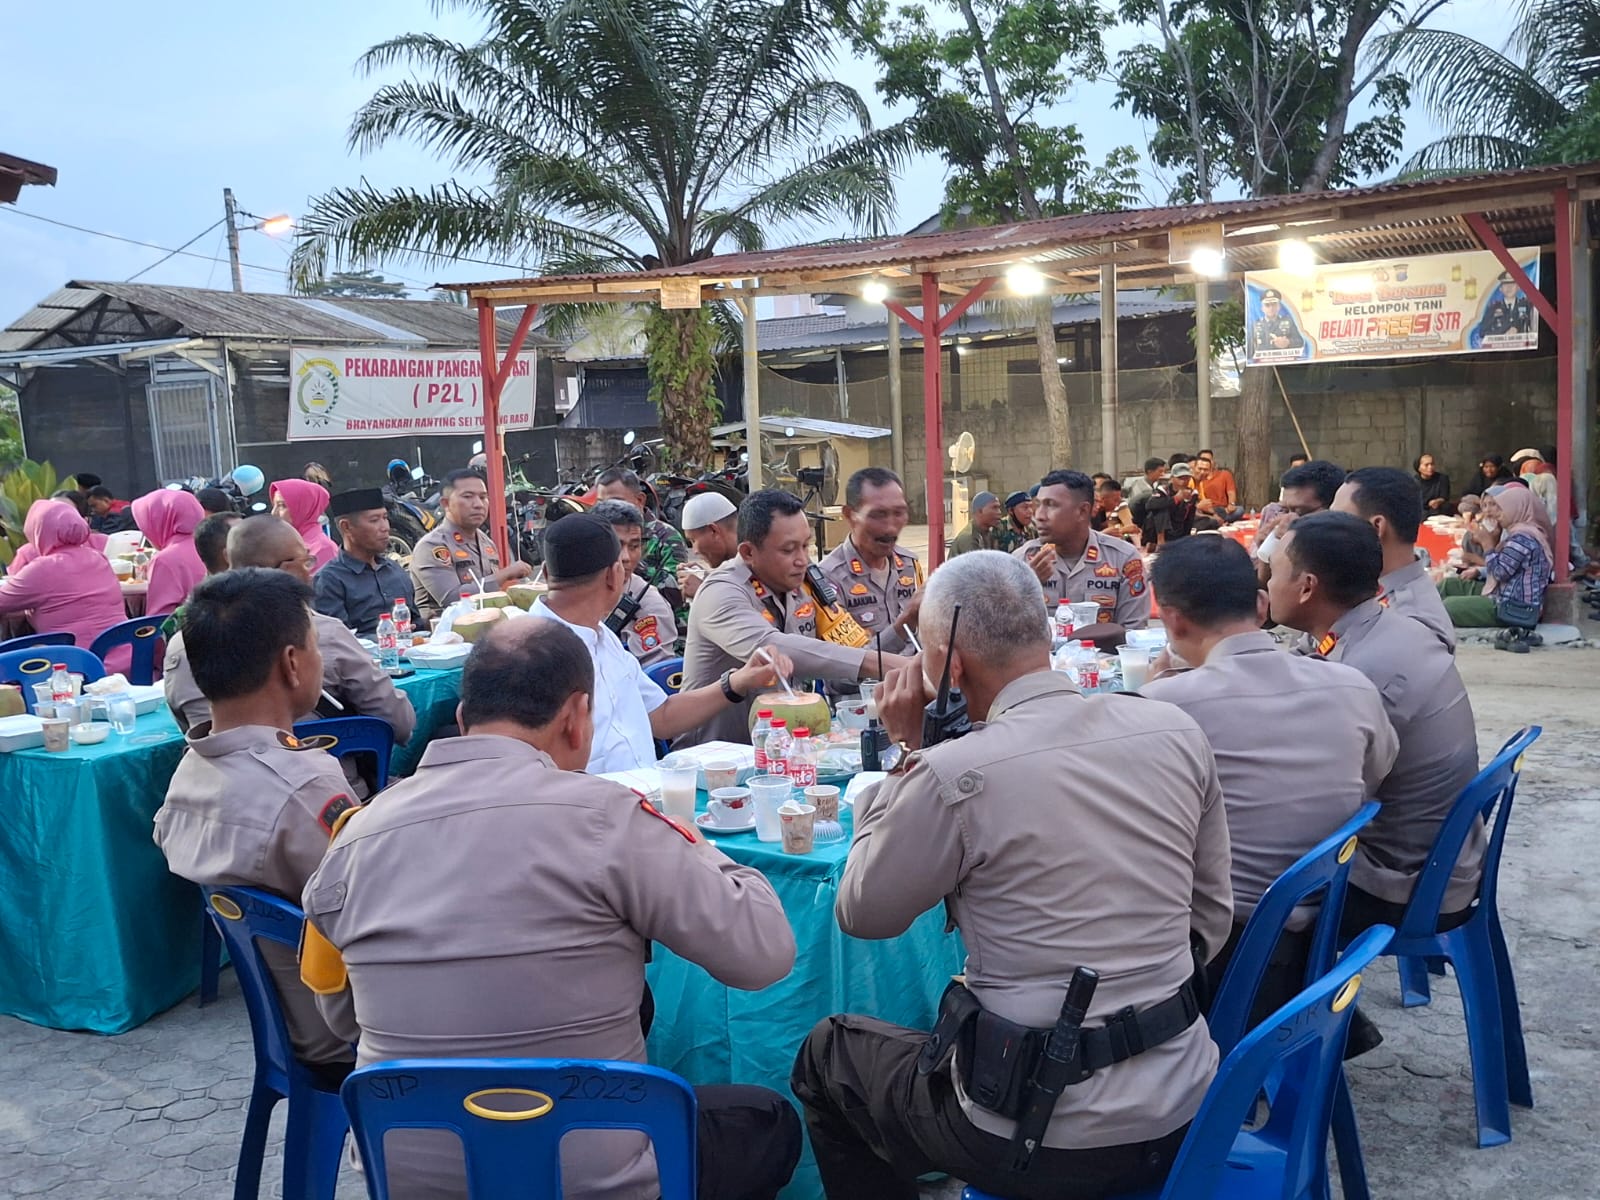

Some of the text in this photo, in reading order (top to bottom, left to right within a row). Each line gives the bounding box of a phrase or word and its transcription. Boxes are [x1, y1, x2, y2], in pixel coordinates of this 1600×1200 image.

[1344, 300, 1443, 316] KELOMPOK TANI
[1320, 318, 1364, 339] BELATI
[1435, 311, 1462, 332] STR
[345, 358, 434, 378] PEKARANGAN
[427, 383, 464, 403] P2L
[346, 418, 412, 430] BHAYANGKARI
[415, 416, 456, 428] RANTING
[458, 416, 472, 427] SEI
[510, 413, 529, 424] RASO
[557, 1074, 648, 1104] 2023
